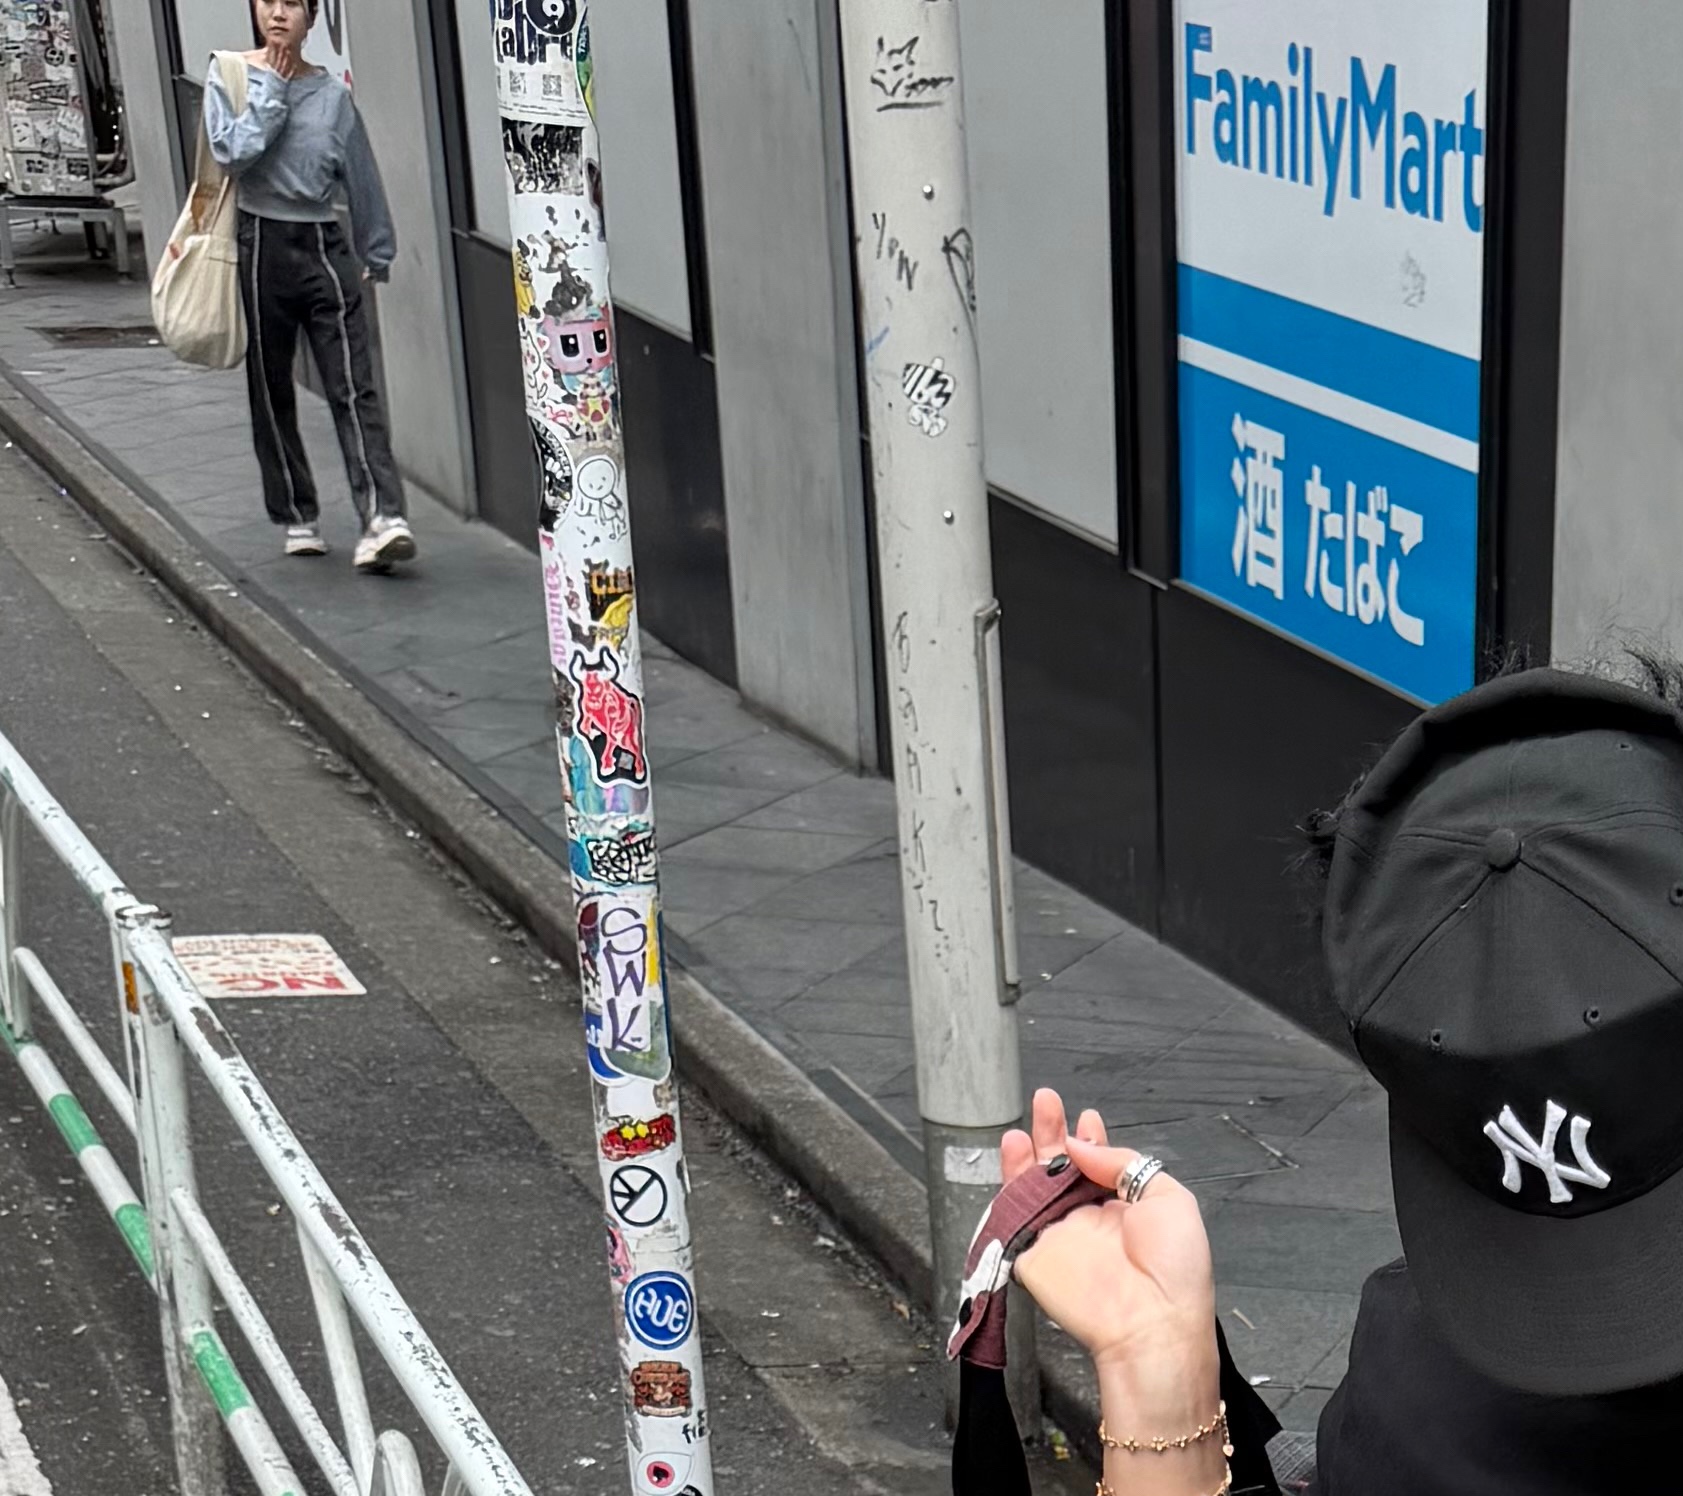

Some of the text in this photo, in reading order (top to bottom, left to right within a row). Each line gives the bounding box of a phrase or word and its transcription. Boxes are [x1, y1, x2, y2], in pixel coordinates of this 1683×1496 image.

[1185, 22, 1485, 234] FamilyMart
[1231, 411, 1425, 647] 酒 たばこ
